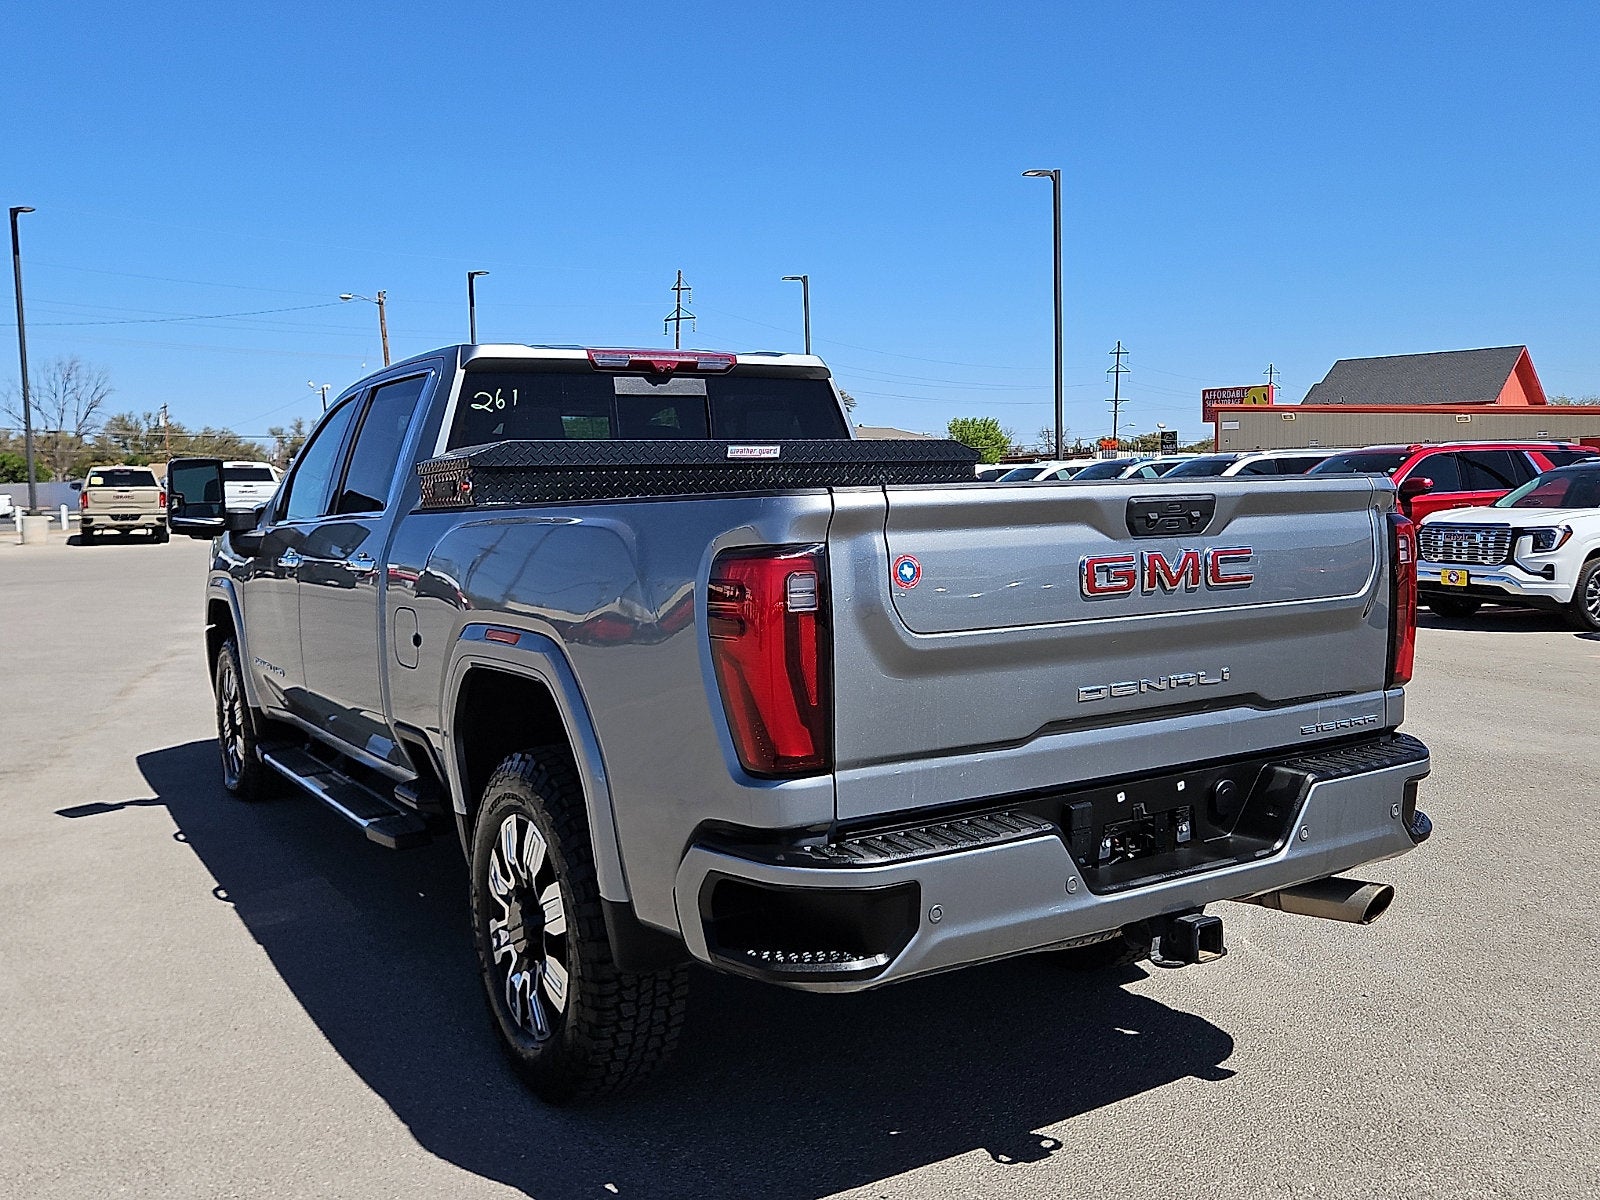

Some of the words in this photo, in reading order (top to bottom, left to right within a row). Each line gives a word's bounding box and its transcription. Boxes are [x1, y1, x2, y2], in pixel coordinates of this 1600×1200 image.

[471, 388, 518, 412] 261
[1205, 389, 1249, 400] AFFORDABLE
[758, 447, 778, 457] guard
[1079, 546, 1254, 599] GMC
[1077, 667, 1231, 702] DENALI
[1300, 714, 1379, 736] SIERRA
